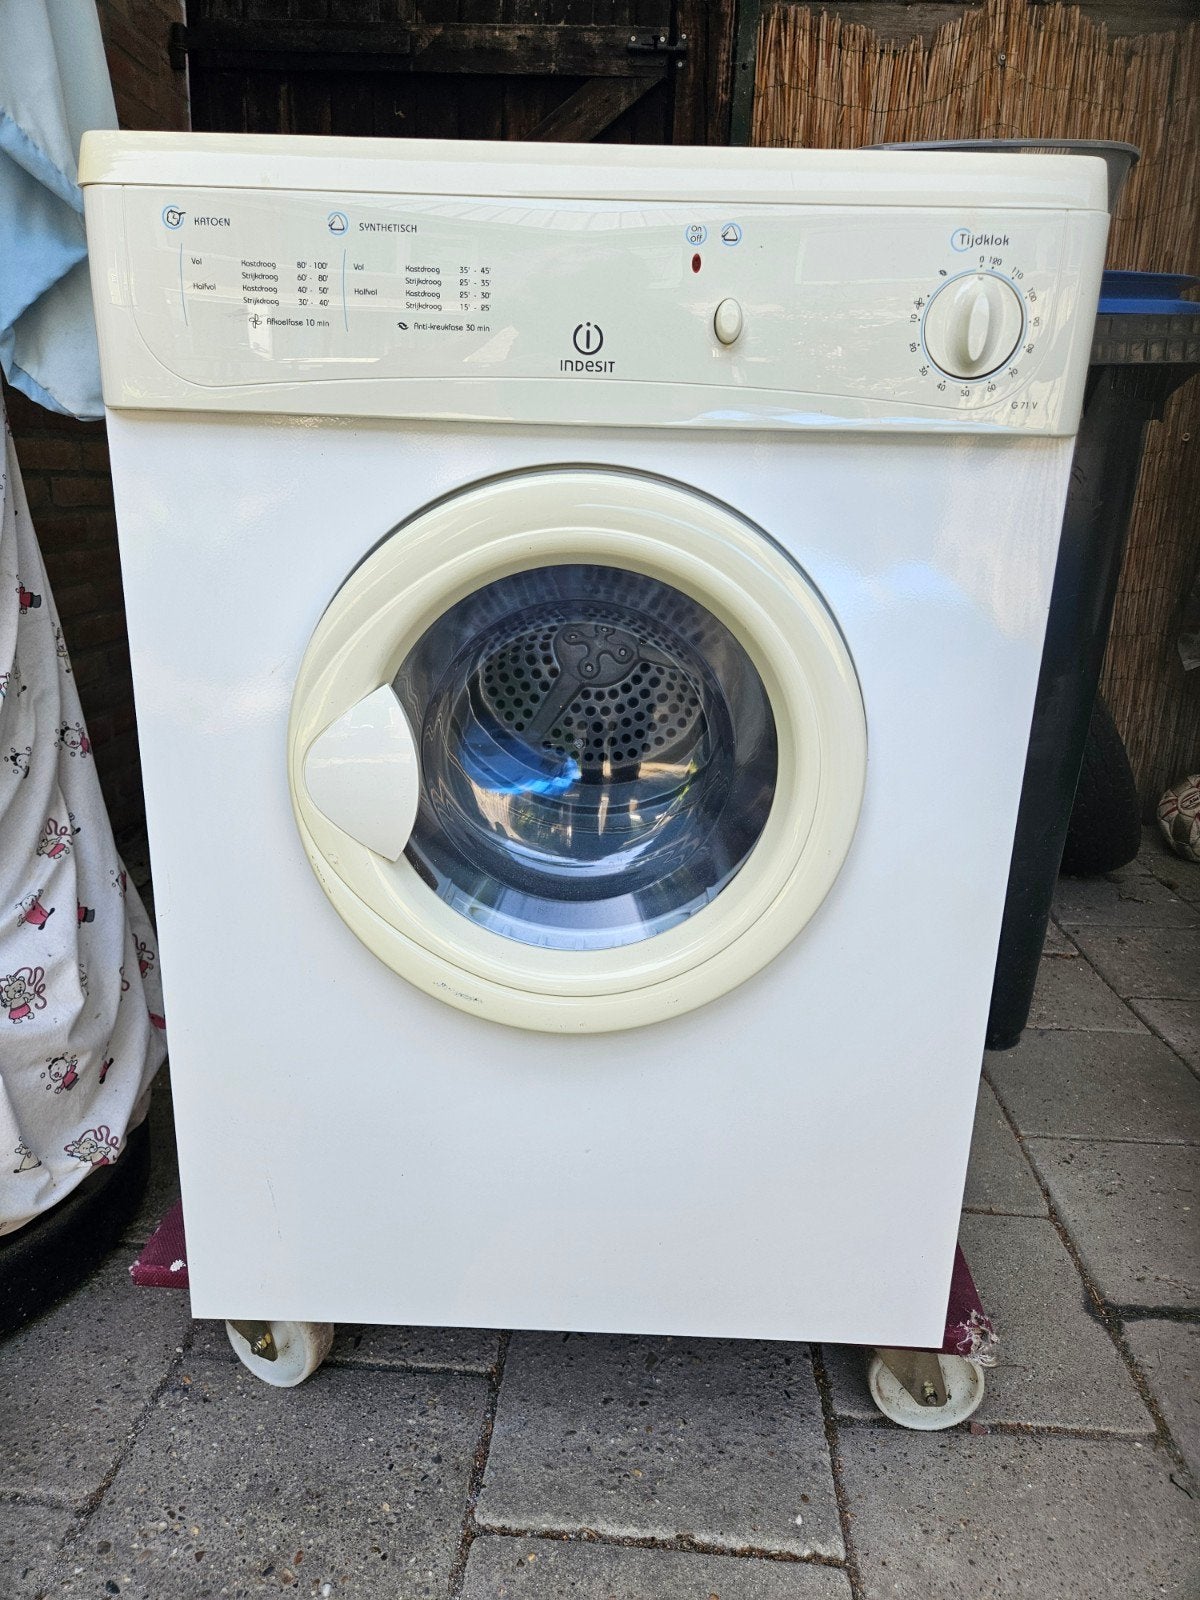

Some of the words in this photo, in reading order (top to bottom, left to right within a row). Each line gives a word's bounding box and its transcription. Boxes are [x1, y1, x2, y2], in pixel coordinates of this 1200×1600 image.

[194, 217, 231, 226] KATOEN
[359, 222, 418, 233] SYNTHETISCH
[690, 235, 702, 243] Off
[960, 233, 1010, 248] Tijdklok
[989, 256, 1002, 266] 120
[353, 263, 364, 271] Vol
[242, 272, 279, 282] Strijkdroog
[405, 278, 442, 287] Strijkdroog
[243, 297, 280, 306] Strijkdroog
[406, 302, 442, 311] Strijkdroog
[267, 318, 303, 326] Afkoelfase
[910, 314, 917, 323] 10
[413, 322, 463, 331] Anti-kreukfase
[936, 383, 946, 391] 40
[987, 384, 996, 392] 60
[961, 389, 970, 397] 50
[1011, 401, 1018, 409] G
